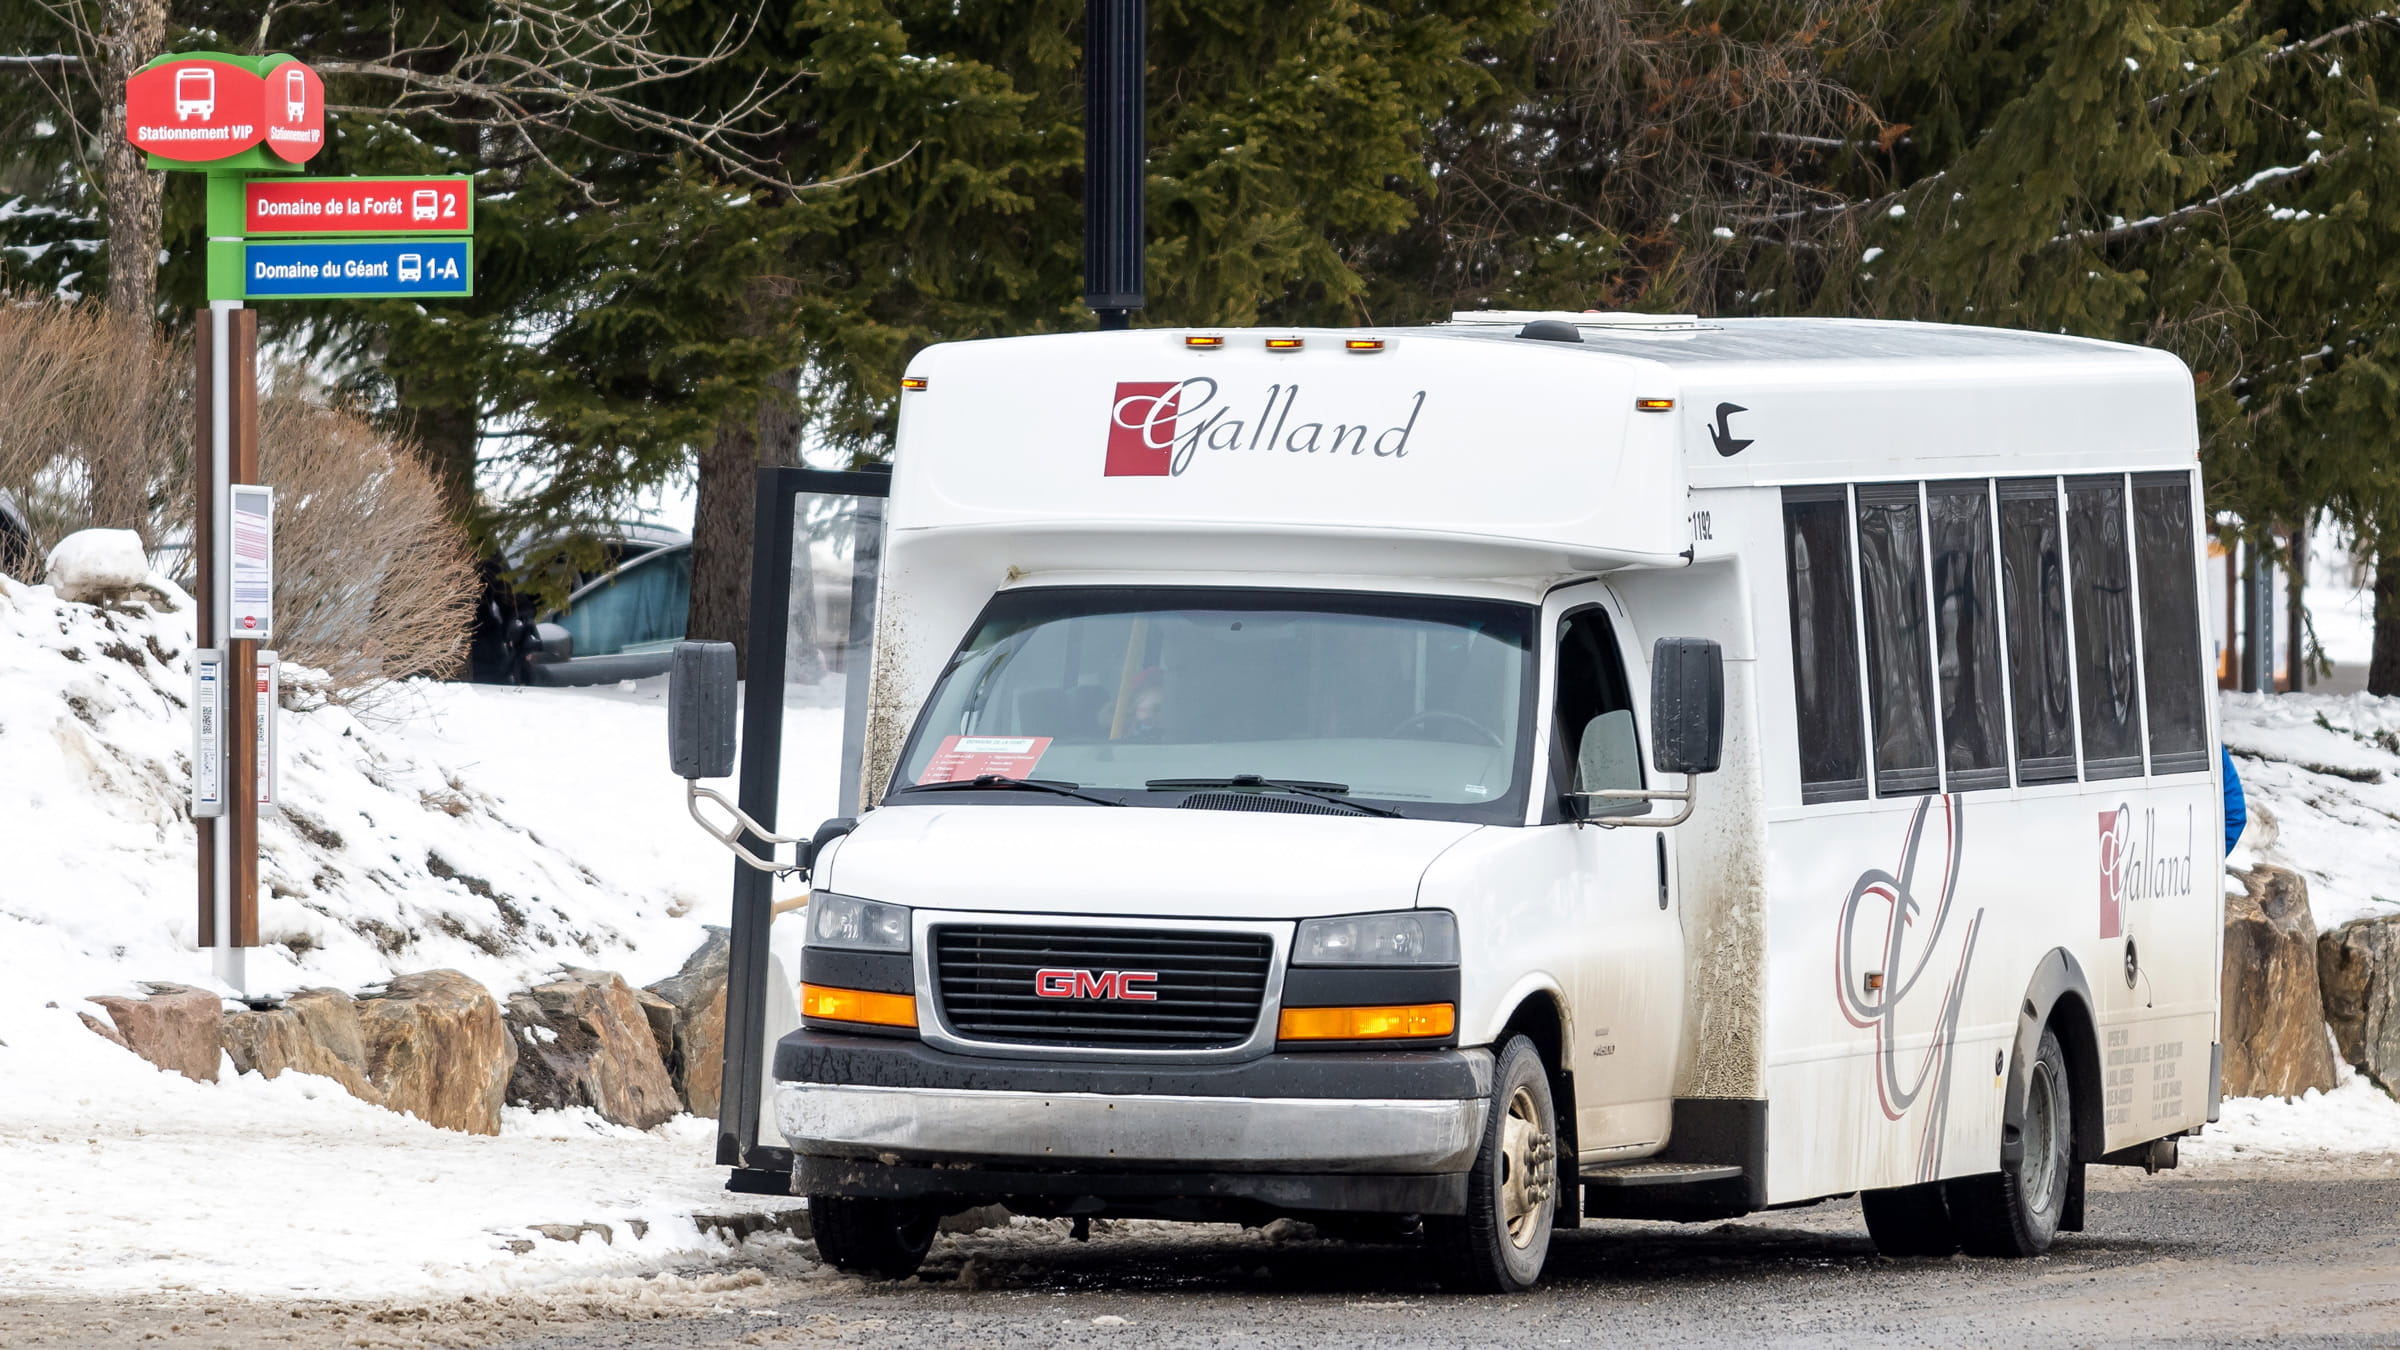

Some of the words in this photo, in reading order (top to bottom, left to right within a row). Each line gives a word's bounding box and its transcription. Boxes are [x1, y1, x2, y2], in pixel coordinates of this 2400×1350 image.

[138, 125, 227, 141] Stationnement
[231, 125, 254, 140] VIP
[270, 126, 309, 143] Stationnement
[311, 129, 320, 143] VIP
[258, 199, 321, 215] Domaine
[325, 198, 343, 215] de
[347, 198, 360, 214] la
[364, 196, 403, 214] Forêt
[443, 194, 456, 217] 2
[255, 262, 318, 279] Domaine
[322, 261, 341, 278] du
[345, 260, 388, 278] Géant
[426, 258, 460, 279] 1-A
[1112, 376, 1427, 477] Galland
[2100, 802, 2192, 936] Galland
[1036, 968, 1158, 1000] GMC
